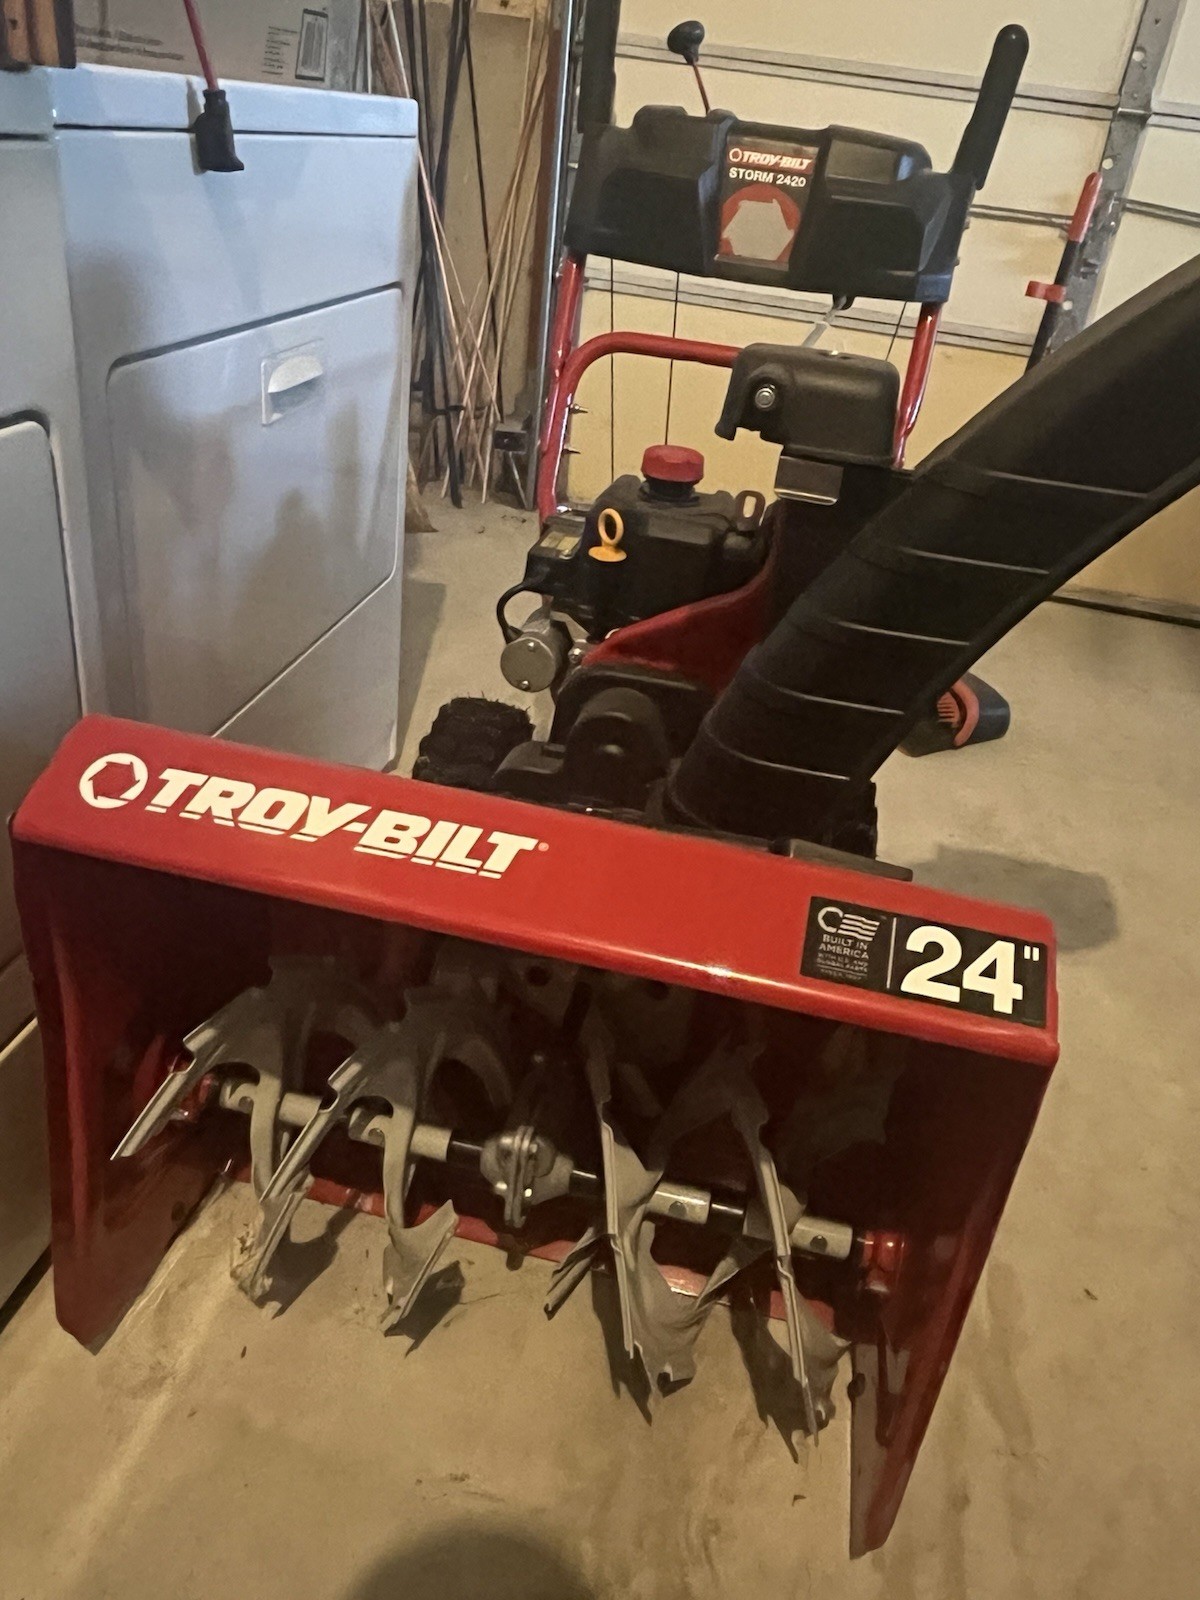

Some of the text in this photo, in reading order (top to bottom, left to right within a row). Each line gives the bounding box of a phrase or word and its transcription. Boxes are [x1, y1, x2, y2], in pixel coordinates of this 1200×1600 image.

[742, 150, 813, 170] TROY-BILT
[729, 167, 807, 188] STORM 2420
[145, 768, 540, 880] TROY-BILT
[818, 943, 870, 960] AMERICA
[822, 933, 868, 951] BUILT IN
[900, 925, 1040, 1015] 24"
